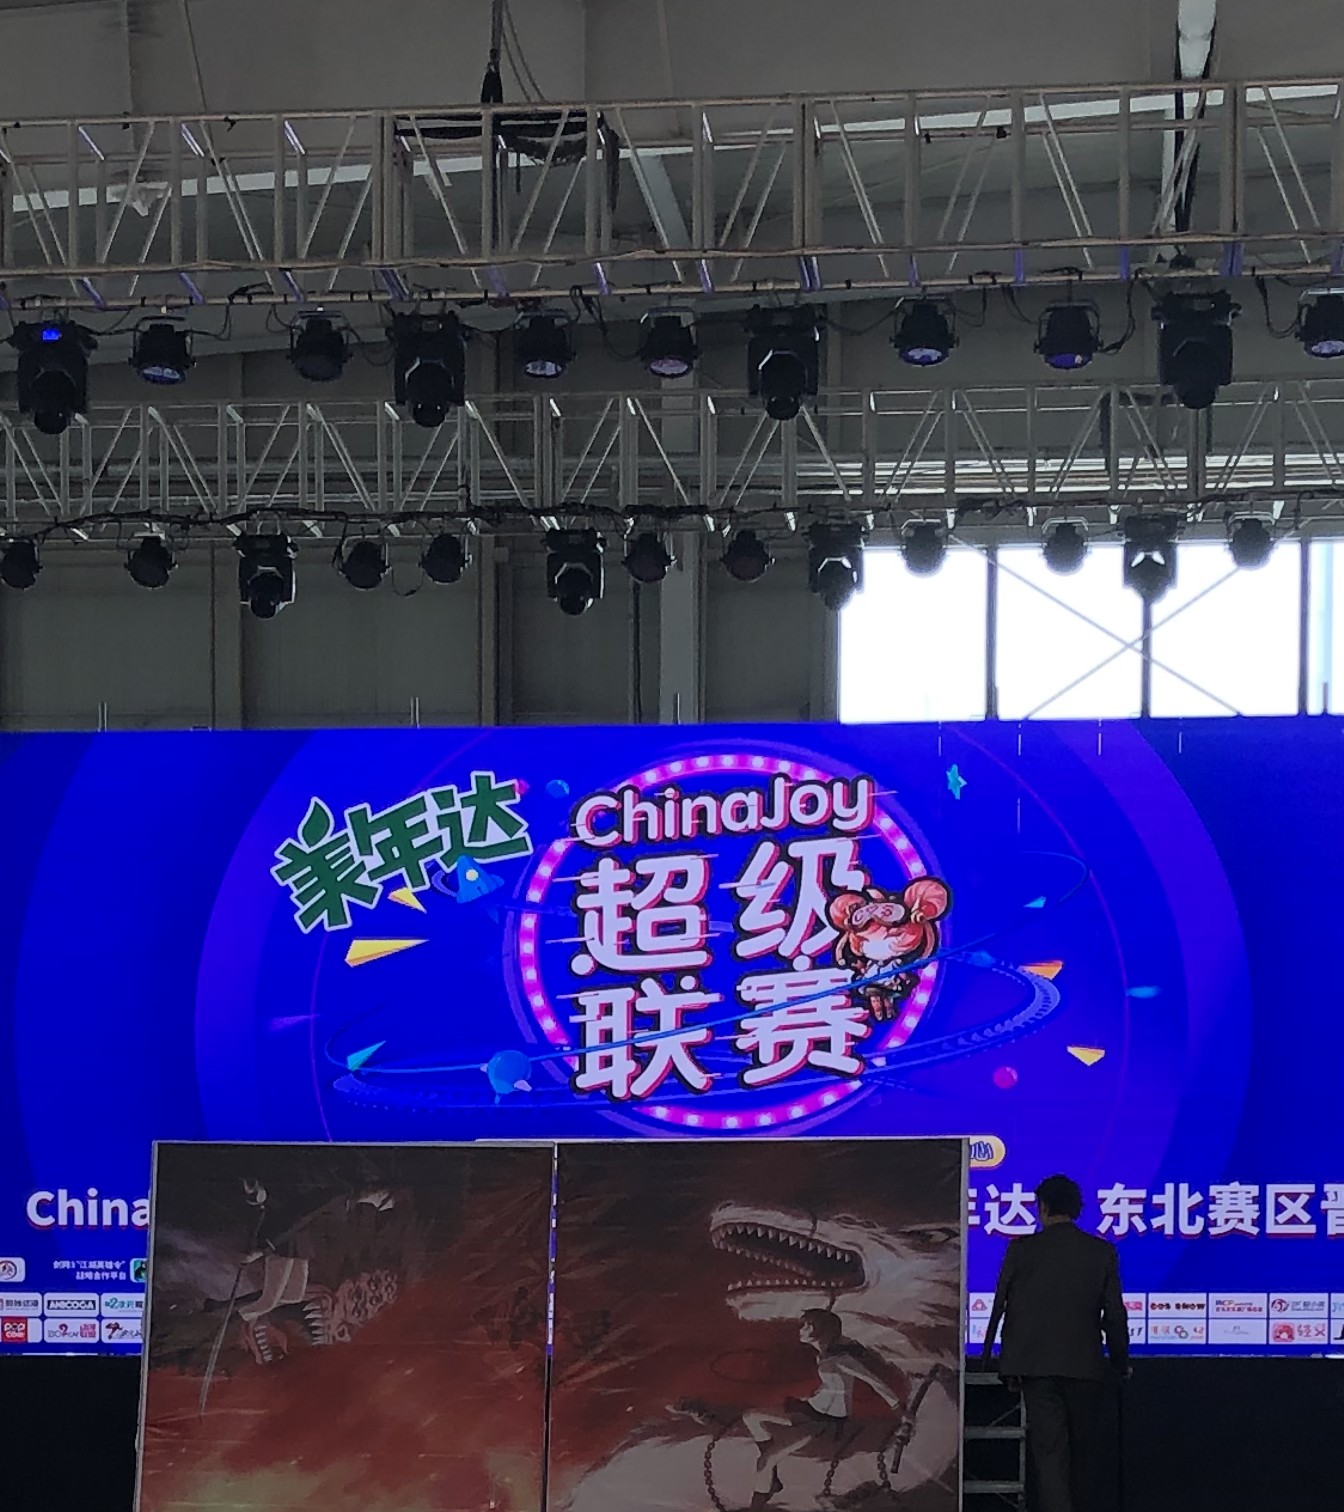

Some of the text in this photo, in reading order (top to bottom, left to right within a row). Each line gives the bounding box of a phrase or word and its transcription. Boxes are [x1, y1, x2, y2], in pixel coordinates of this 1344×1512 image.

[273, 770, 532, 932] 美年达
[573, 776, 873, 847] ChinaJoy
[569, 837, 867, 975] 超级
[572, 962, 867, 1097] 联赛
[968, 1183, 1037, 1236] 达
